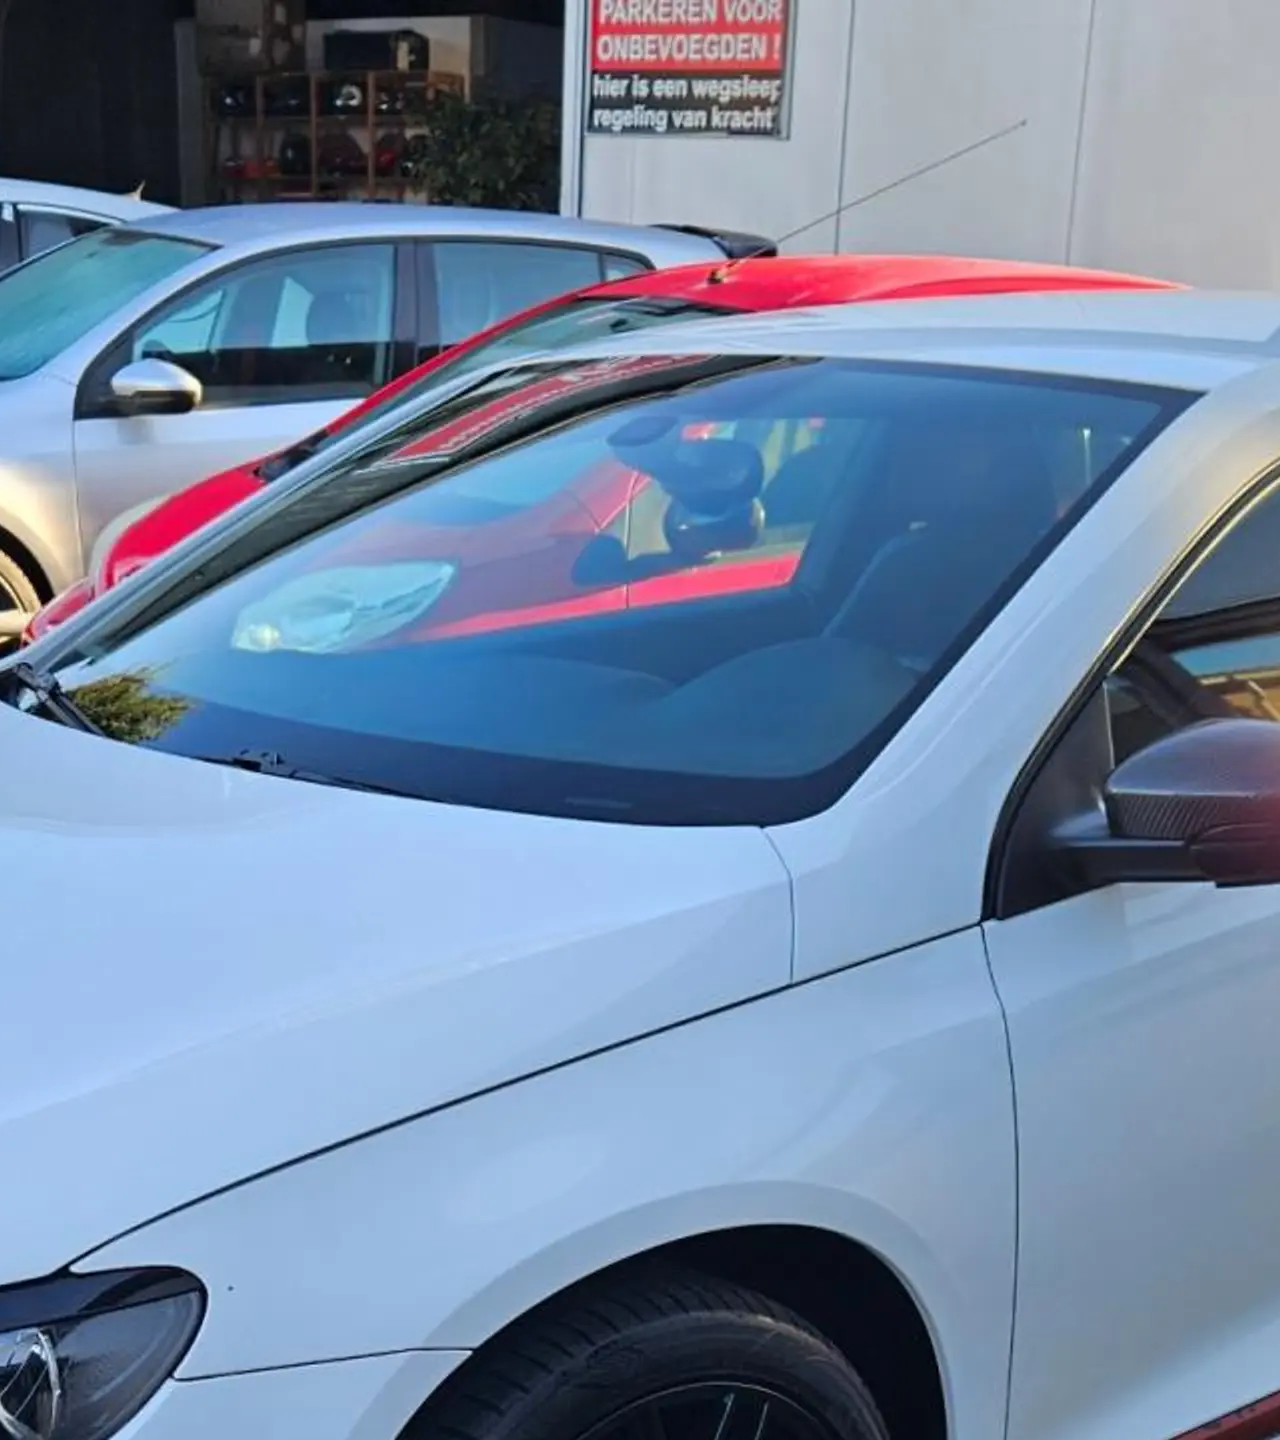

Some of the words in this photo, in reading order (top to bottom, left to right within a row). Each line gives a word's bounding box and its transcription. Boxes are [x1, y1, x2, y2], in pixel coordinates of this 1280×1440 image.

[599, 0, 717, 24] PARKEREN
[724, 0, 783, 22] VOOR
[597, 34, 767, 61] ONBEVOEGDEN
[772, 34, 782, 61] !
[594, 74, 629, 98] hier
[632, 74, 650, 98] is
[653, 79, 687, 98] een
[594, 104, 667, 131] regeling
[671, 109, 707, 128] van
[711, 106, 773, 129] kracht
